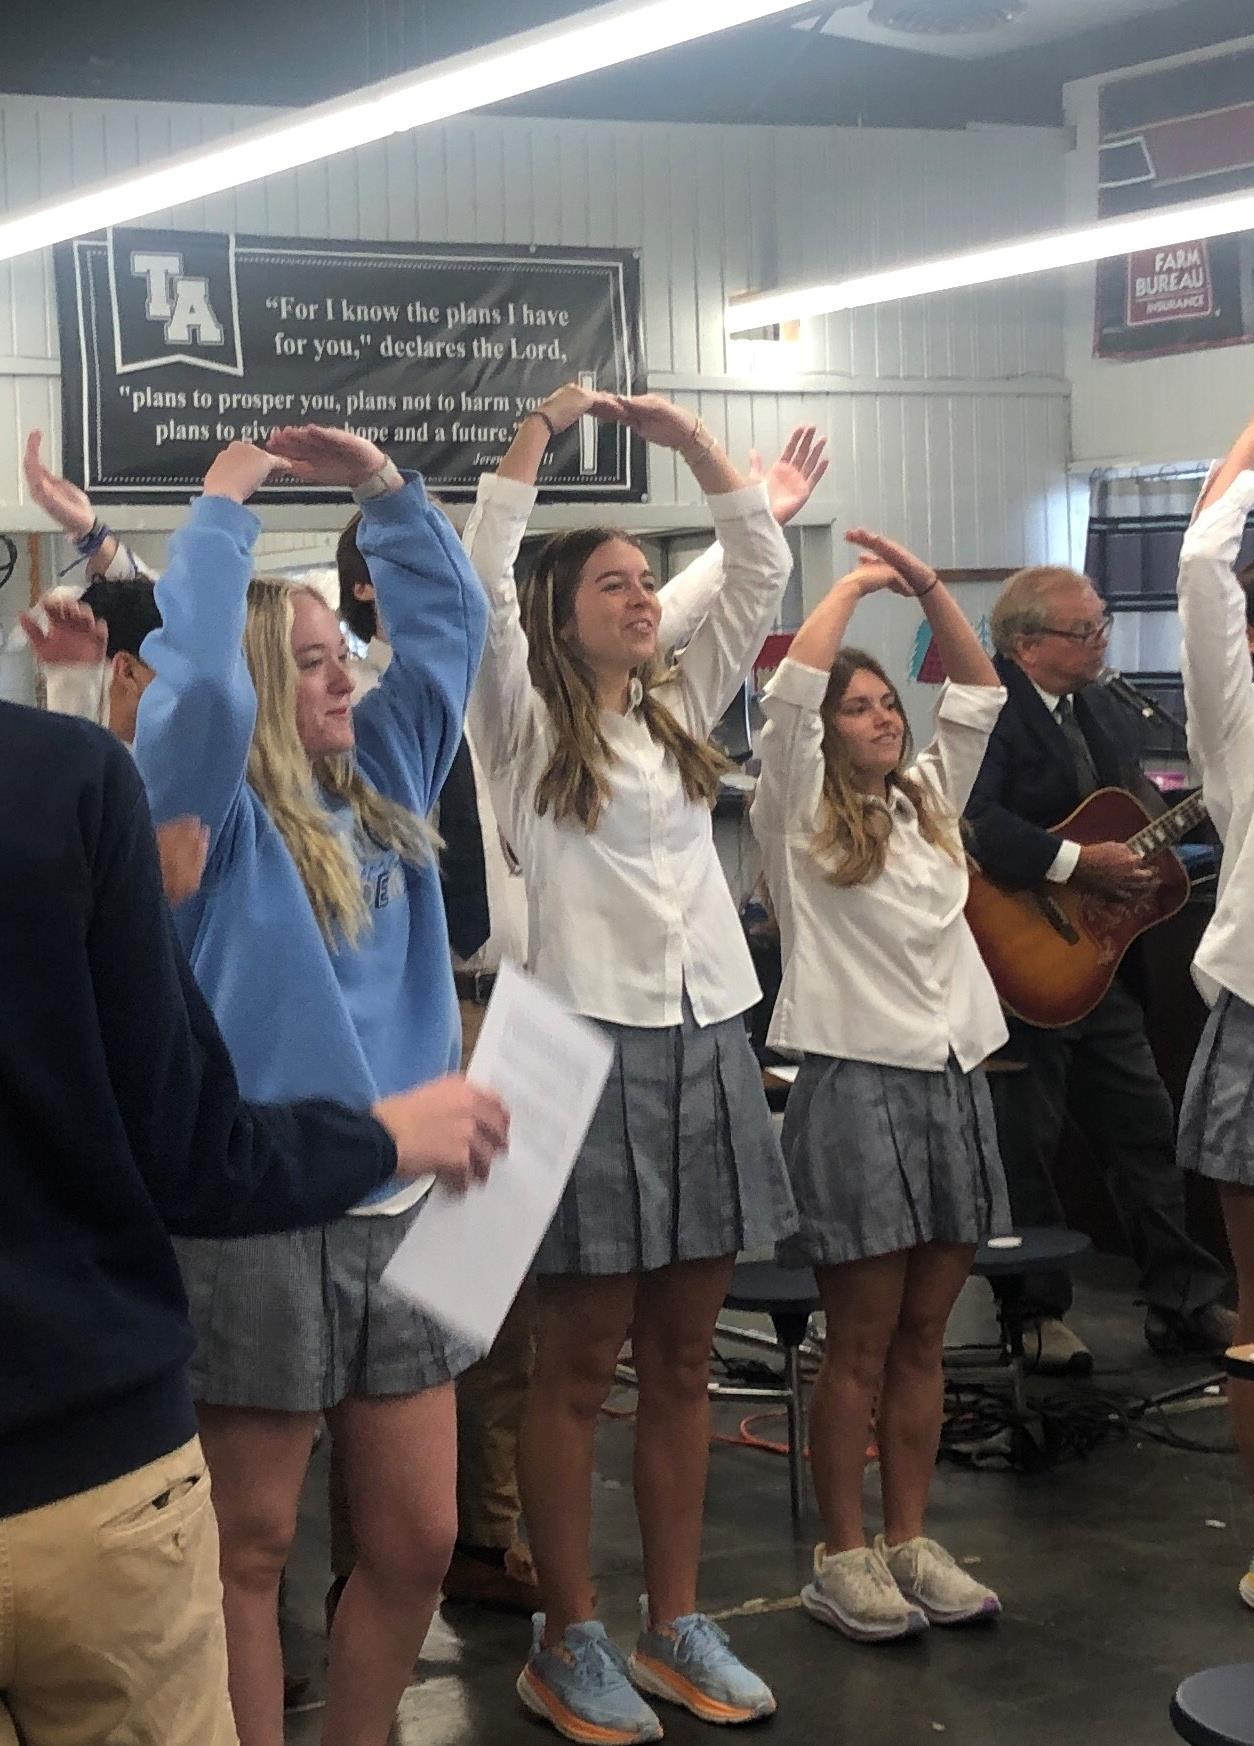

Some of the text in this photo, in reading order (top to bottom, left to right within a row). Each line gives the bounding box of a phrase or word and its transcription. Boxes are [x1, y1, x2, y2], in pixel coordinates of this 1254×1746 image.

[1155, 247, 1201, 273] FARM
[1135, 267, 1204, 297] BUREAU
[265, 296, 569, 329] “For I know the plans I have
[274, 331, 308, 356] for
[379, 334, 467, 358] declares
[472, 336, 504, 360] the
[510, 337, 568, 365] Lord,
[119, 385, 187, 413] "plans
[192, 389, 212, 410] to
[218, 392, 295, 415] prosper
[300, 394, 341, 416] you,
[346, 389, 398, 416] plans
[402, 392, 432, 412] not
[437, 392, 456, 412] to
[461, 390, 510, 412] harm
[155, 418, 210, 446] plans
[216, 420, 235, 440] to
[241, 420, 273, 444] giv
[393, 421, 429, 443] and
[434, 425, 446, 443] a
